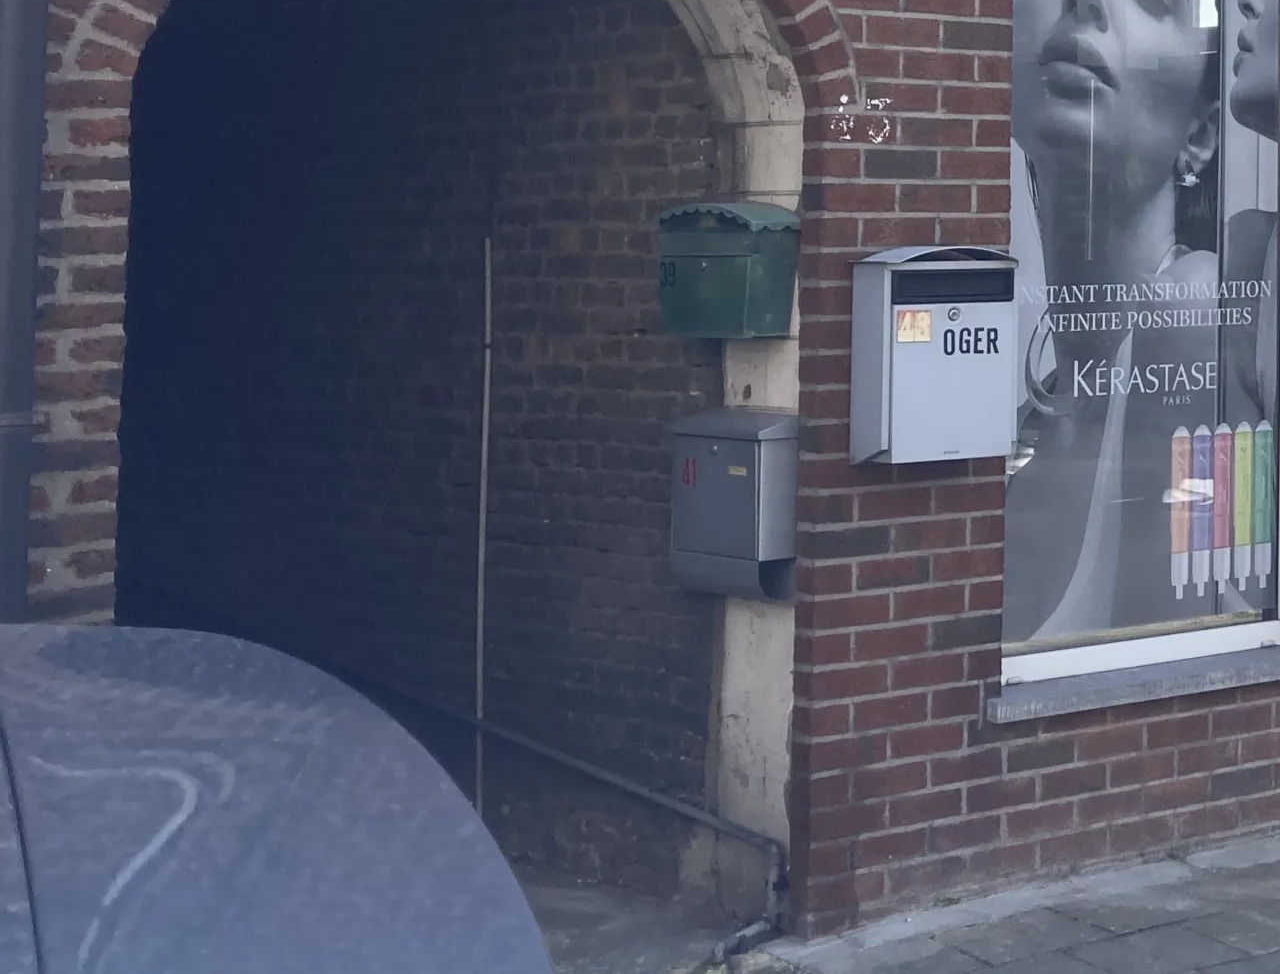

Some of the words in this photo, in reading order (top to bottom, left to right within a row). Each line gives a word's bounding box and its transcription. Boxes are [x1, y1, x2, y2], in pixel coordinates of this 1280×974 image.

[1018, 284, 1098, 304] NSTANT
[1102, 280, 1273, 304] TRANSFORMATION
[1126, 307, 1253, 330] POSSIBILITIES
[943, 327, 1000, 356] OGER
[1072, 358, 1218, 398] KÉRASTASE
[1162, 395, 1191, 406] PARIS
